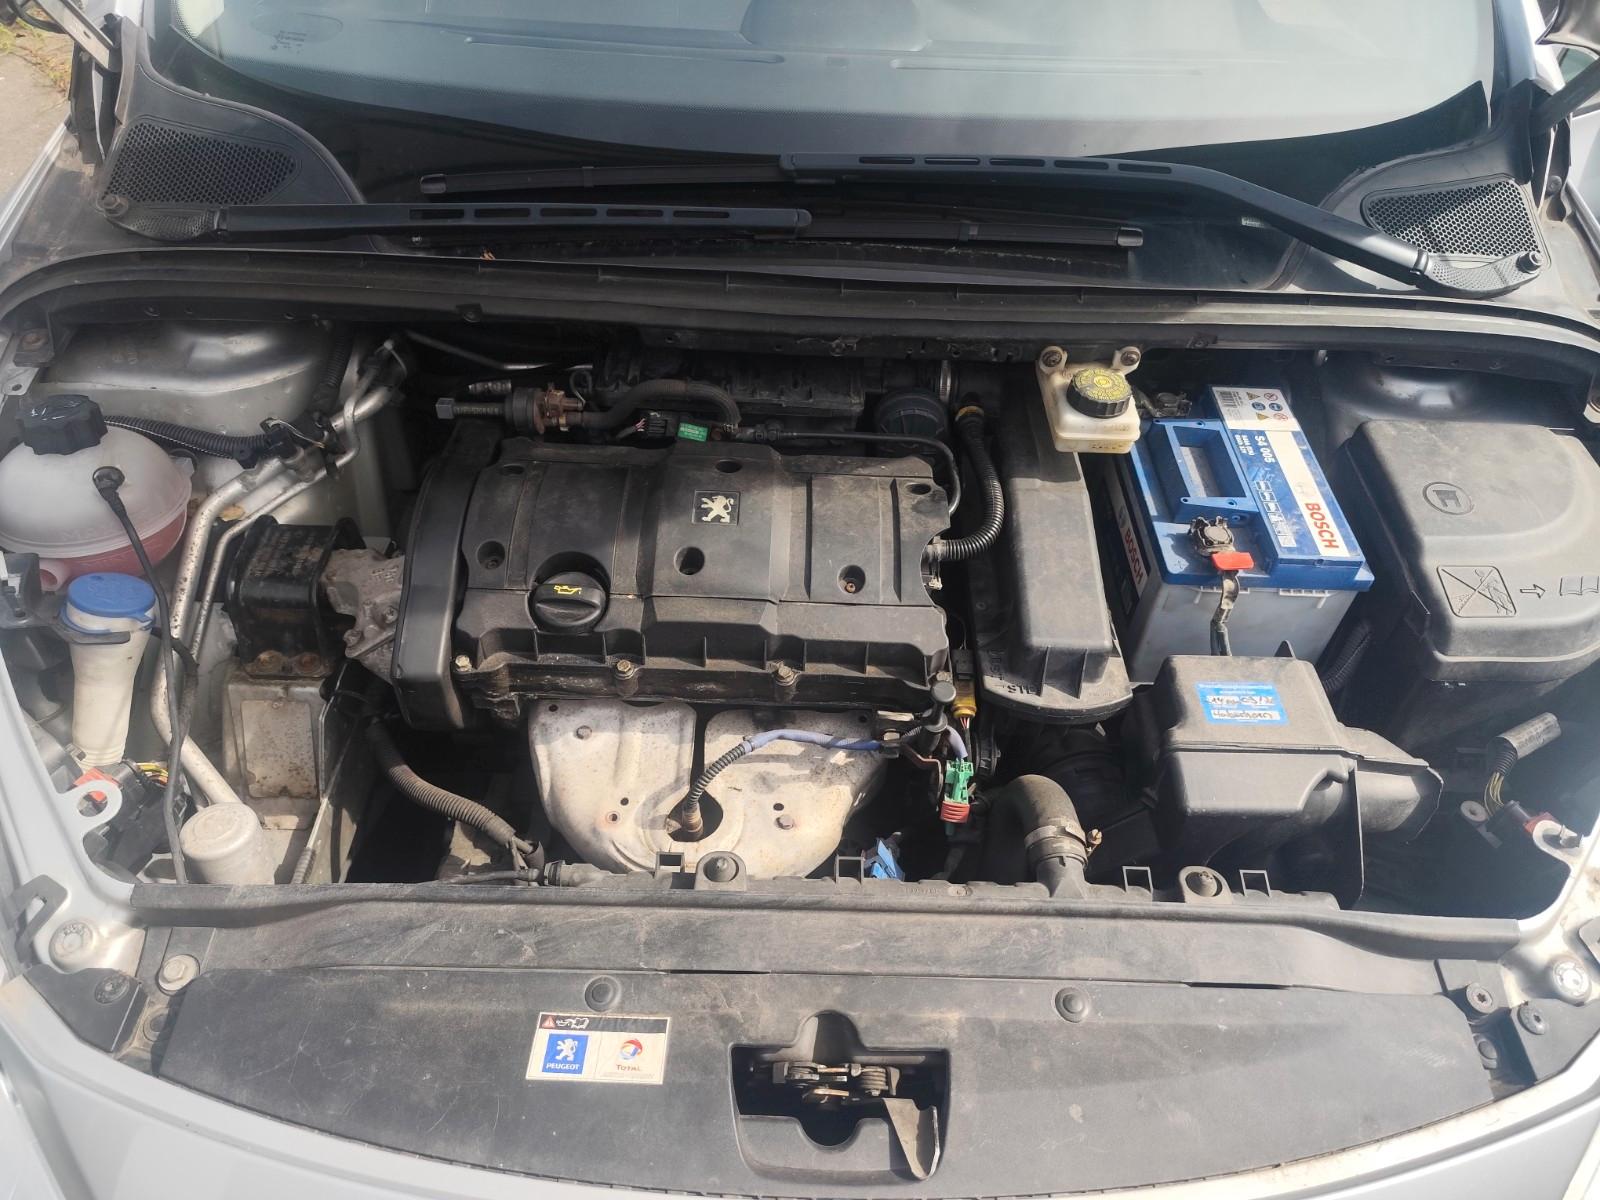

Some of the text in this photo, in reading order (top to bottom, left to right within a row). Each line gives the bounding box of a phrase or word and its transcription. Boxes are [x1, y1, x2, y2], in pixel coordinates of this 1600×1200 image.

[1255, 435, 1276, 463] S4 005
[1305, 502, 1339, 548] BOSCH
[1125, 527, 1143, 584] BOSCH
